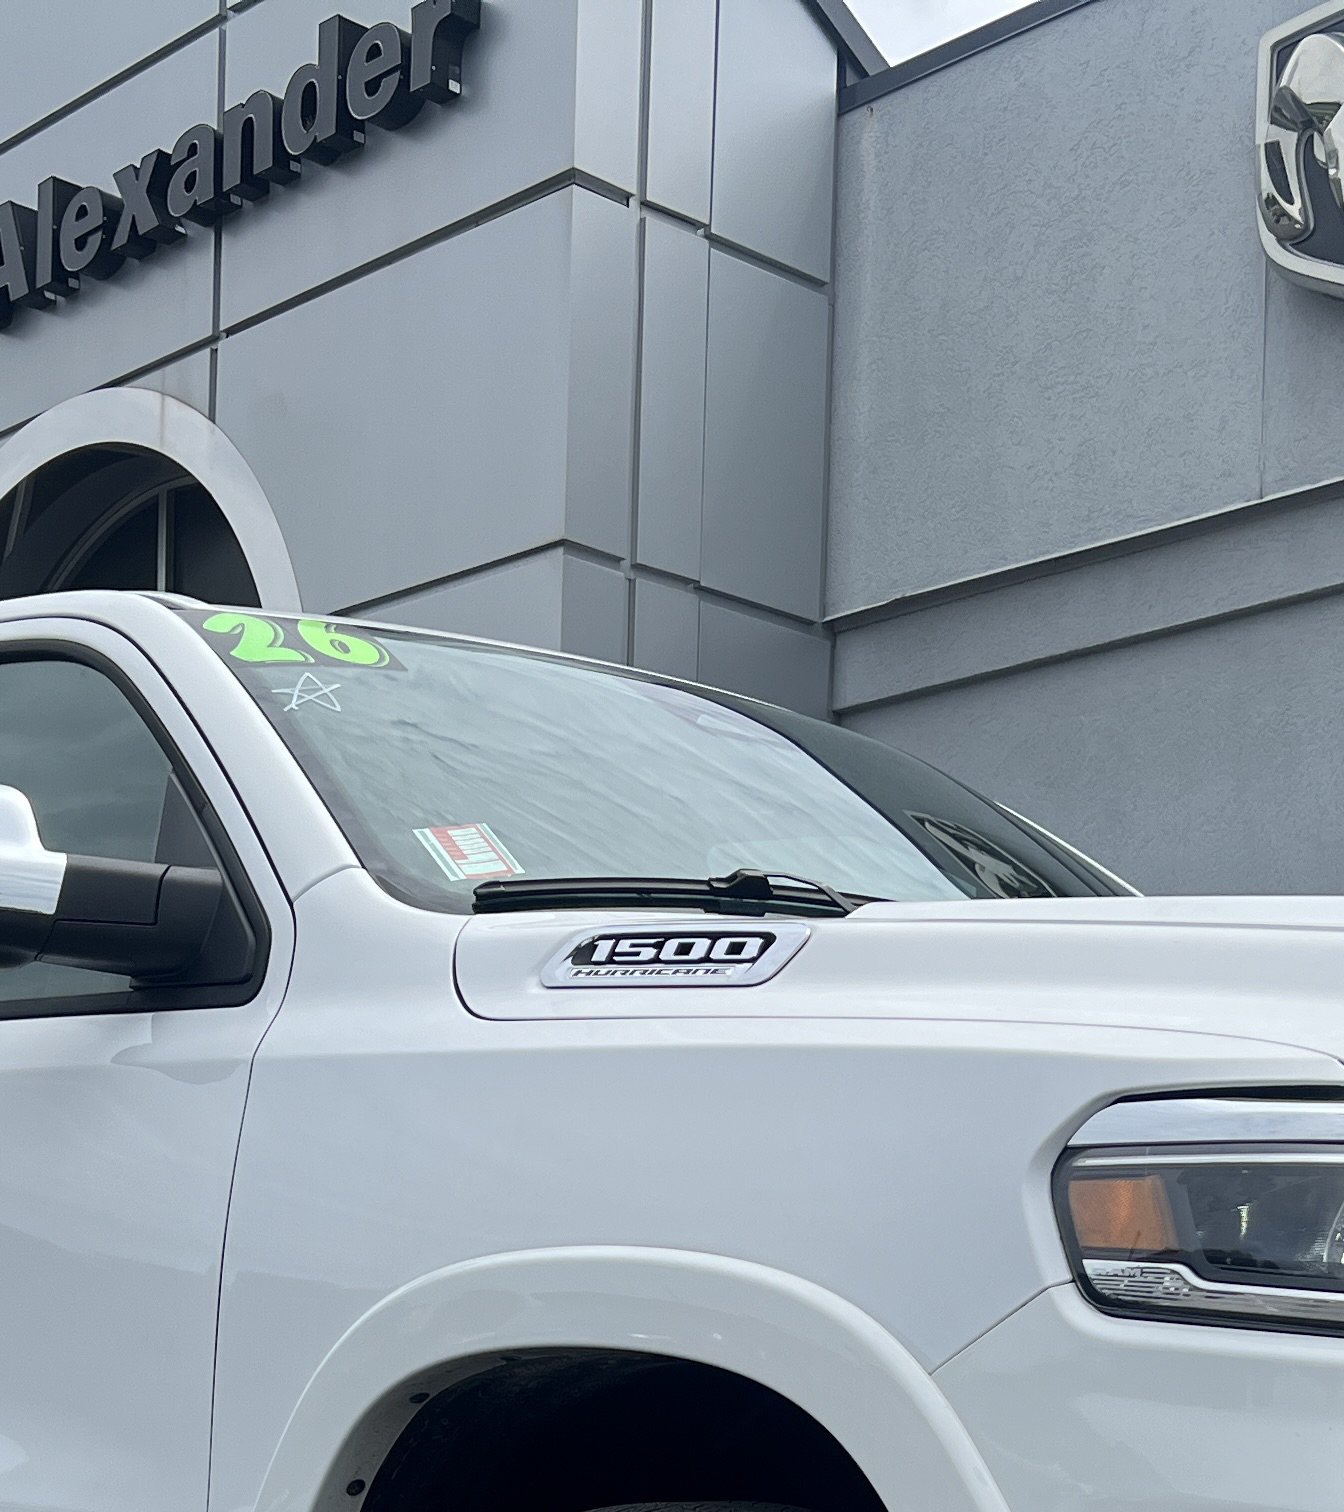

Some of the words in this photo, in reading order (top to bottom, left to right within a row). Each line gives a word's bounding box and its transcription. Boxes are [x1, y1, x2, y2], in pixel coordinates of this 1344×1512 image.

[203, 612, 389, 667] 26
[590, 937, 763, 963] 1500
[571, 966, 732, 978] HURRICANE
